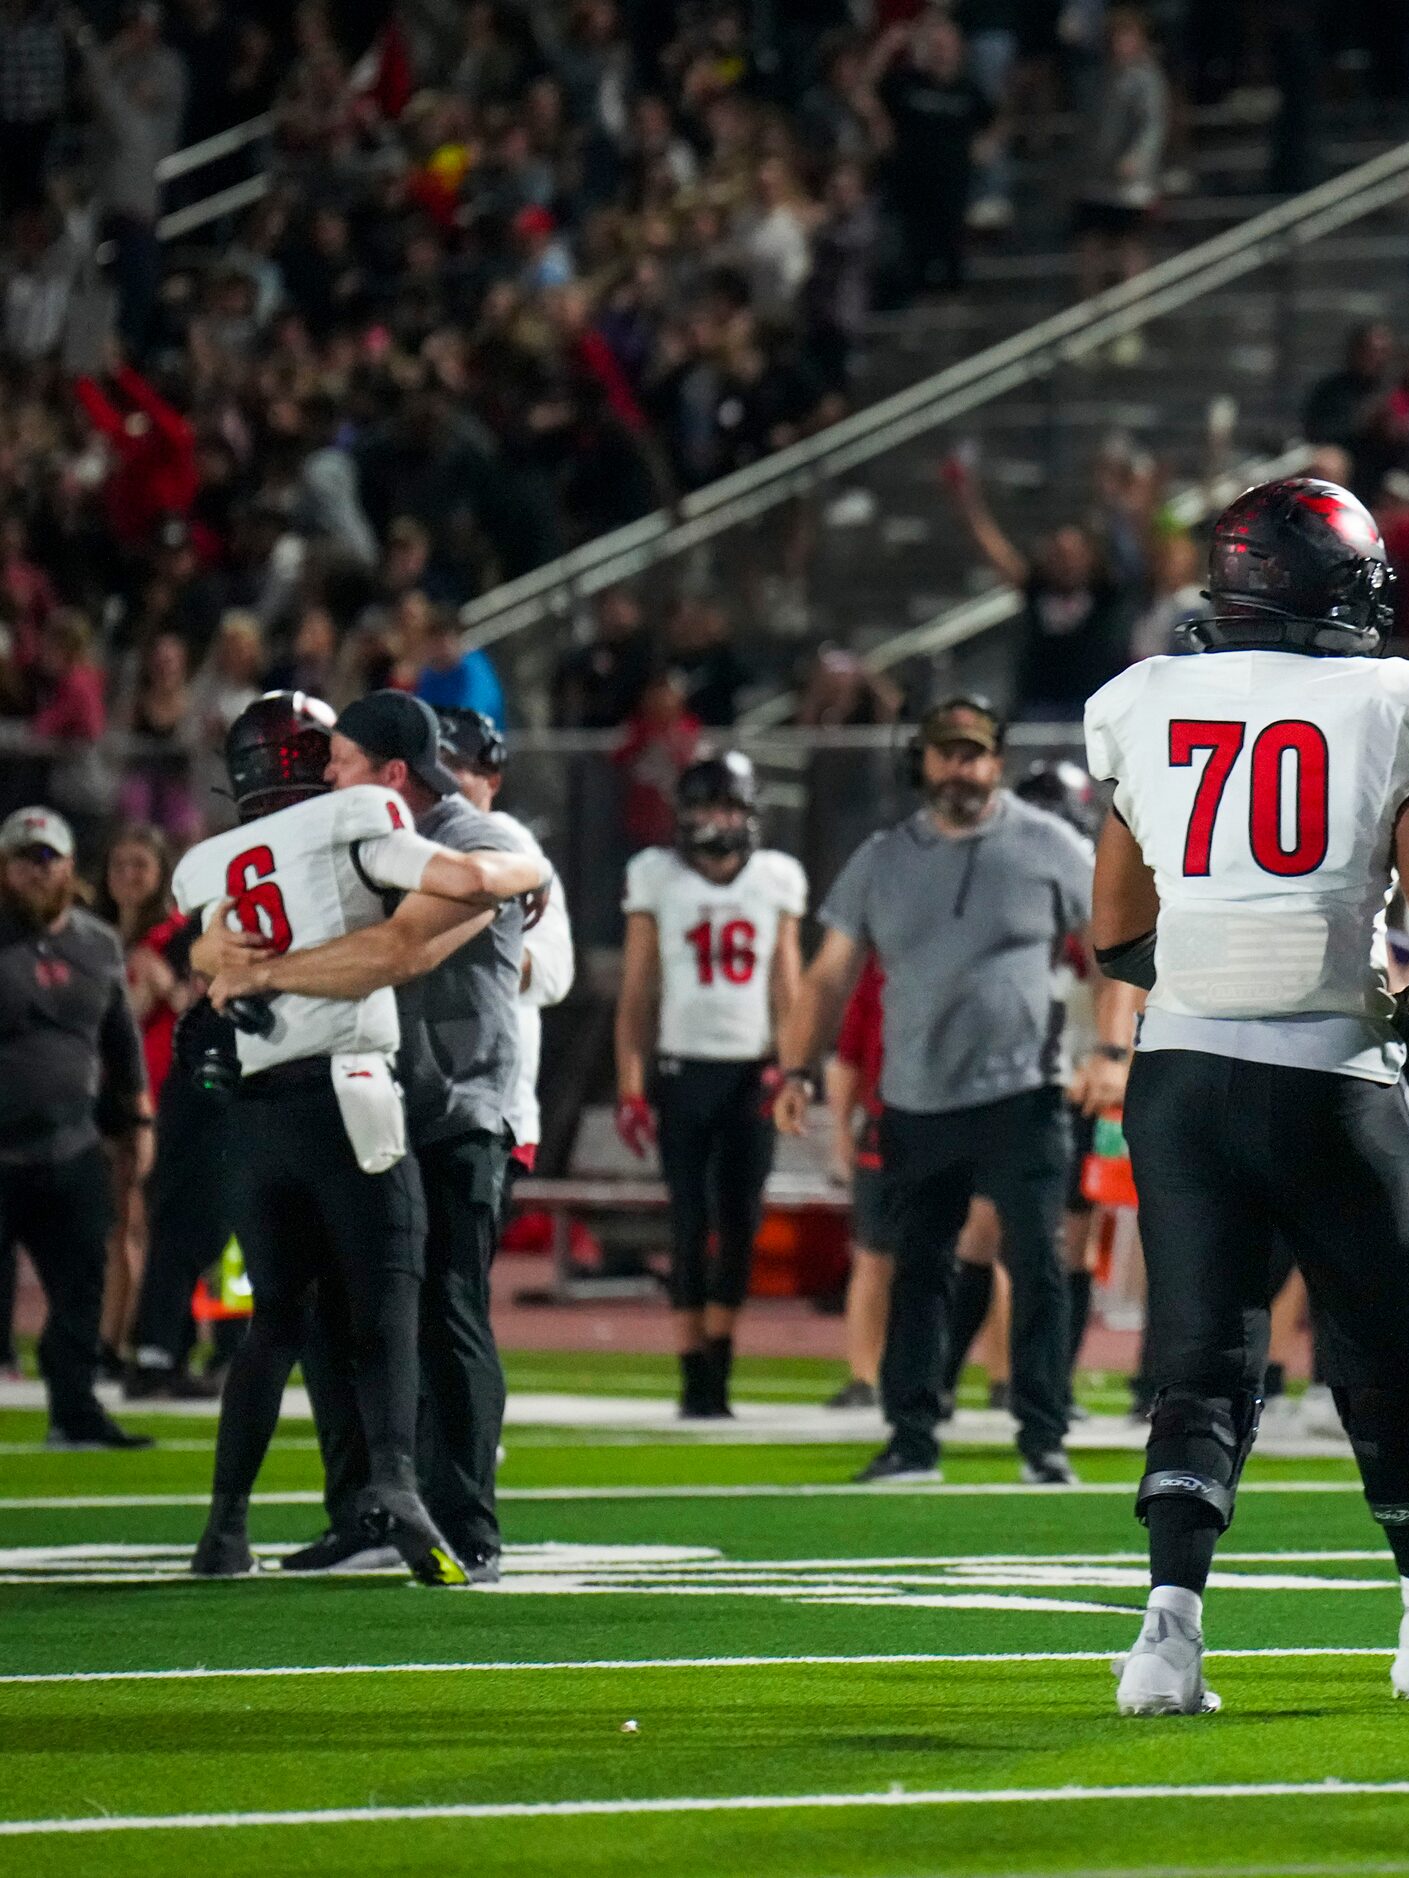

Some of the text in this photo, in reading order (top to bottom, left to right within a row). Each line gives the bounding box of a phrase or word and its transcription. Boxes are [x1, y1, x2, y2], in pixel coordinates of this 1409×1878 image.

[1168, 718, 1329, 878] 70
[226, 844, 293, 954] 6
[684, 919, 757, 986] 16
